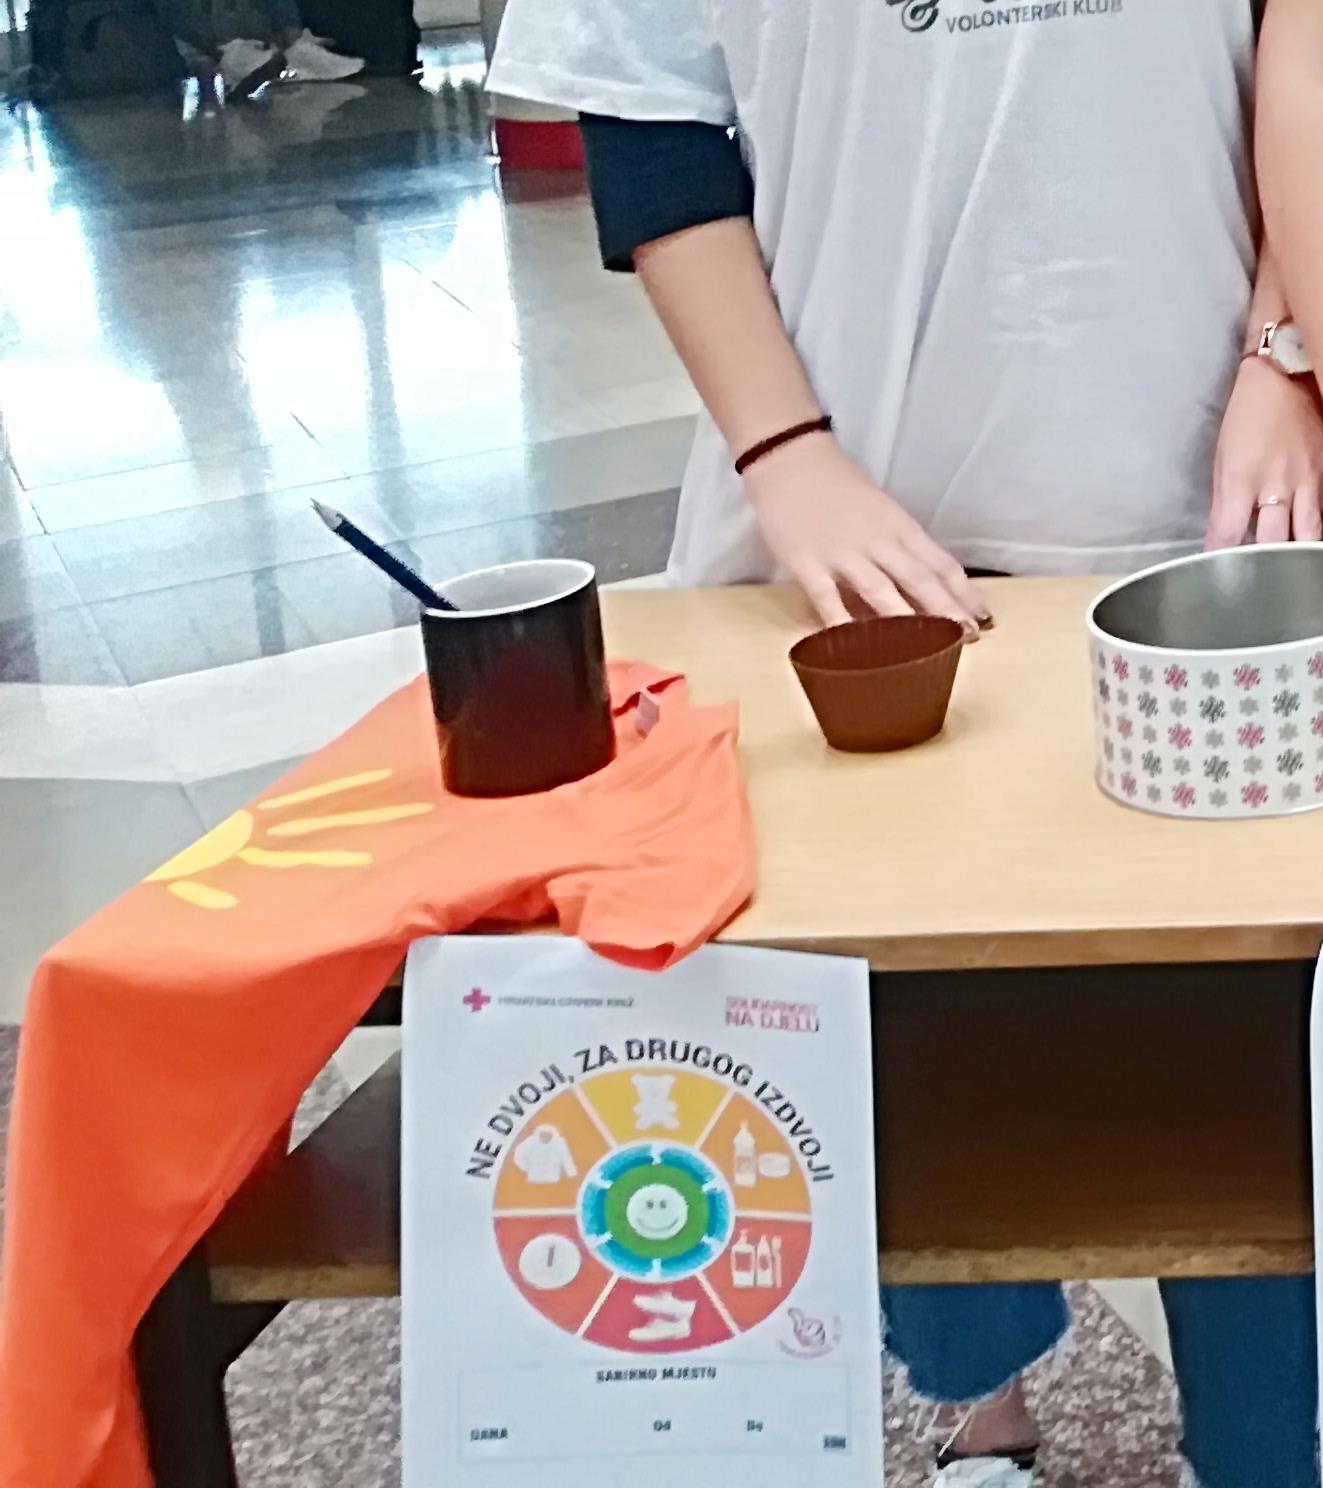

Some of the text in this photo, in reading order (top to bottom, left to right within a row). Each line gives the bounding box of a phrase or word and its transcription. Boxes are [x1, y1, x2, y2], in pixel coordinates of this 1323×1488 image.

[946, 1, 1067, 34] VOLONTERSKI
[465, 1144, 502, 1181] NE
[575, 1043, 618, 1075] ZA
[624, 1038, 755, 1089] DRUGOG
[754, 1079, 835, 1184] IZDVOJI
